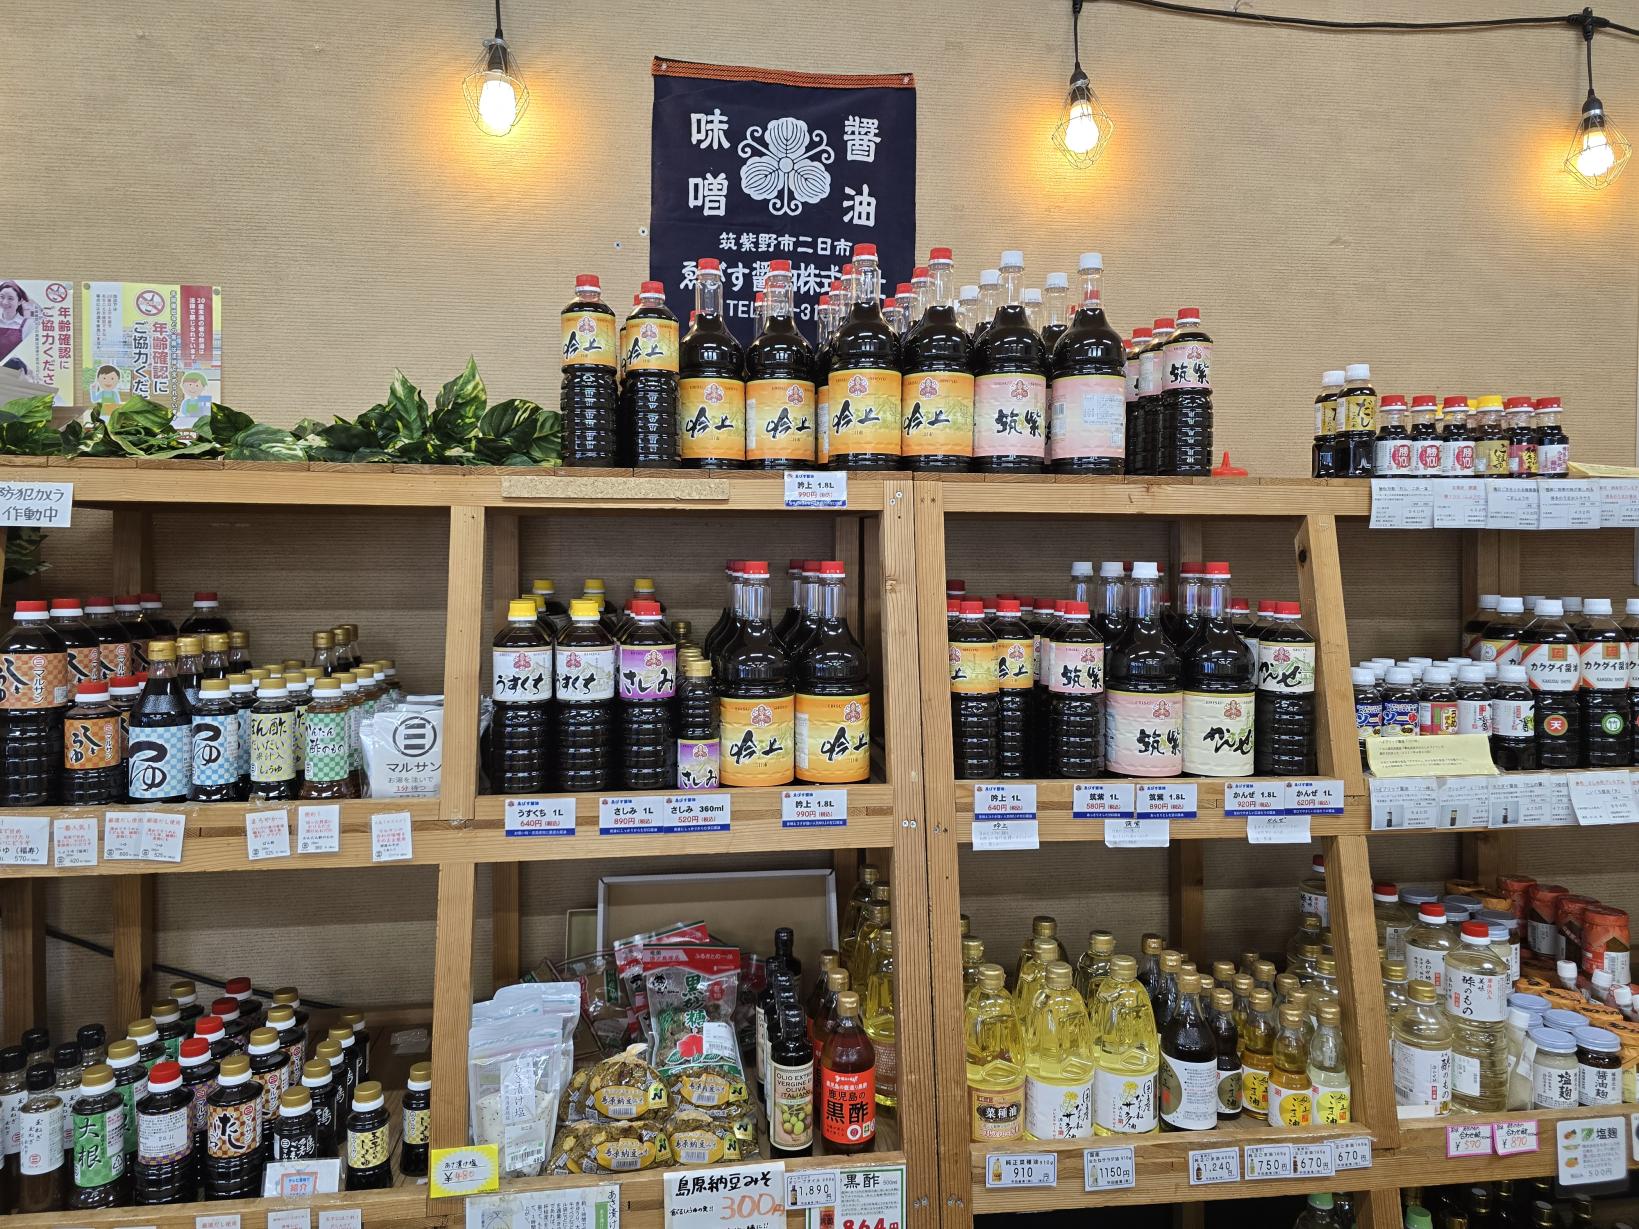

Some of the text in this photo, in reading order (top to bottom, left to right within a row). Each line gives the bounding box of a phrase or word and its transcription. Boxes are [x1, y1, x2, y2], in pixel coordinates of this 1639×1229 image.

[688, 109, 730, 216] 味噌
[842, 116, 881, 227] 醤油
[719, 232, 853, 260] 筑紫野市二日市
[42, 306, 55, 386] ご協力くださ
[57, 306, 72, 370] 年齢確認に
[132, 320, 149, 400] ご協力くだ
[152, 321, 169, 394] 年齢確認に
[0, 486, 64, 502] 防犯カメラ
[2, 506, 58, 523] 作動中
[33, 669, 43, 704] マルサン
[496, 672, 545, 696] うすくち
[555, 672, 597, 695] すくち
[623, 668, 674, 695] さしみ
[1551, 721, 1561, 730] 天
[1607, 719, 1618, 730] 竹
[193, 722, 222, 768] つゆ
[309, 738, 345, 756] 酢のもの
[130, 740, 168, 792] つゆ
[259, 764, 283, 775] しょうゆ
[386, 762, 441, 773] マルサン
[388, 776, 434, 784] お湯を注いで
[681, 768, 718, 788] さしみ
[396, 785, 427, 793] 1分待つ
[777, 1073, 792, 1082] OLIO
[777, 1080, 806, 1089] VERGINE
[786, 1086, 806, 1094] OLIVA
[828, 1090, 865, 1101] 鹿児島の
[826, 1101, 868, 1125] 黒酢
[78, 1117, 102, 1170] 大根
[1301, 1157, 1322, 1169] 670
[1339, 1151, 1358, 1162] 670
[1014, 1167, 1033, 1178] 910
[1099, 1167, 1130, 1180] 1150円
[1204, 1161, 1230, 1173] 1,240
[1258, 1160, 1280, 1171] 750
[290, 1183, 308, 1192] 紹介
[676, 1171, 773, 1197] 島原納豆みそ
[843, 1174, 880, 1189] 黒酢
[799, 1184, 829, 1197] 1,890
